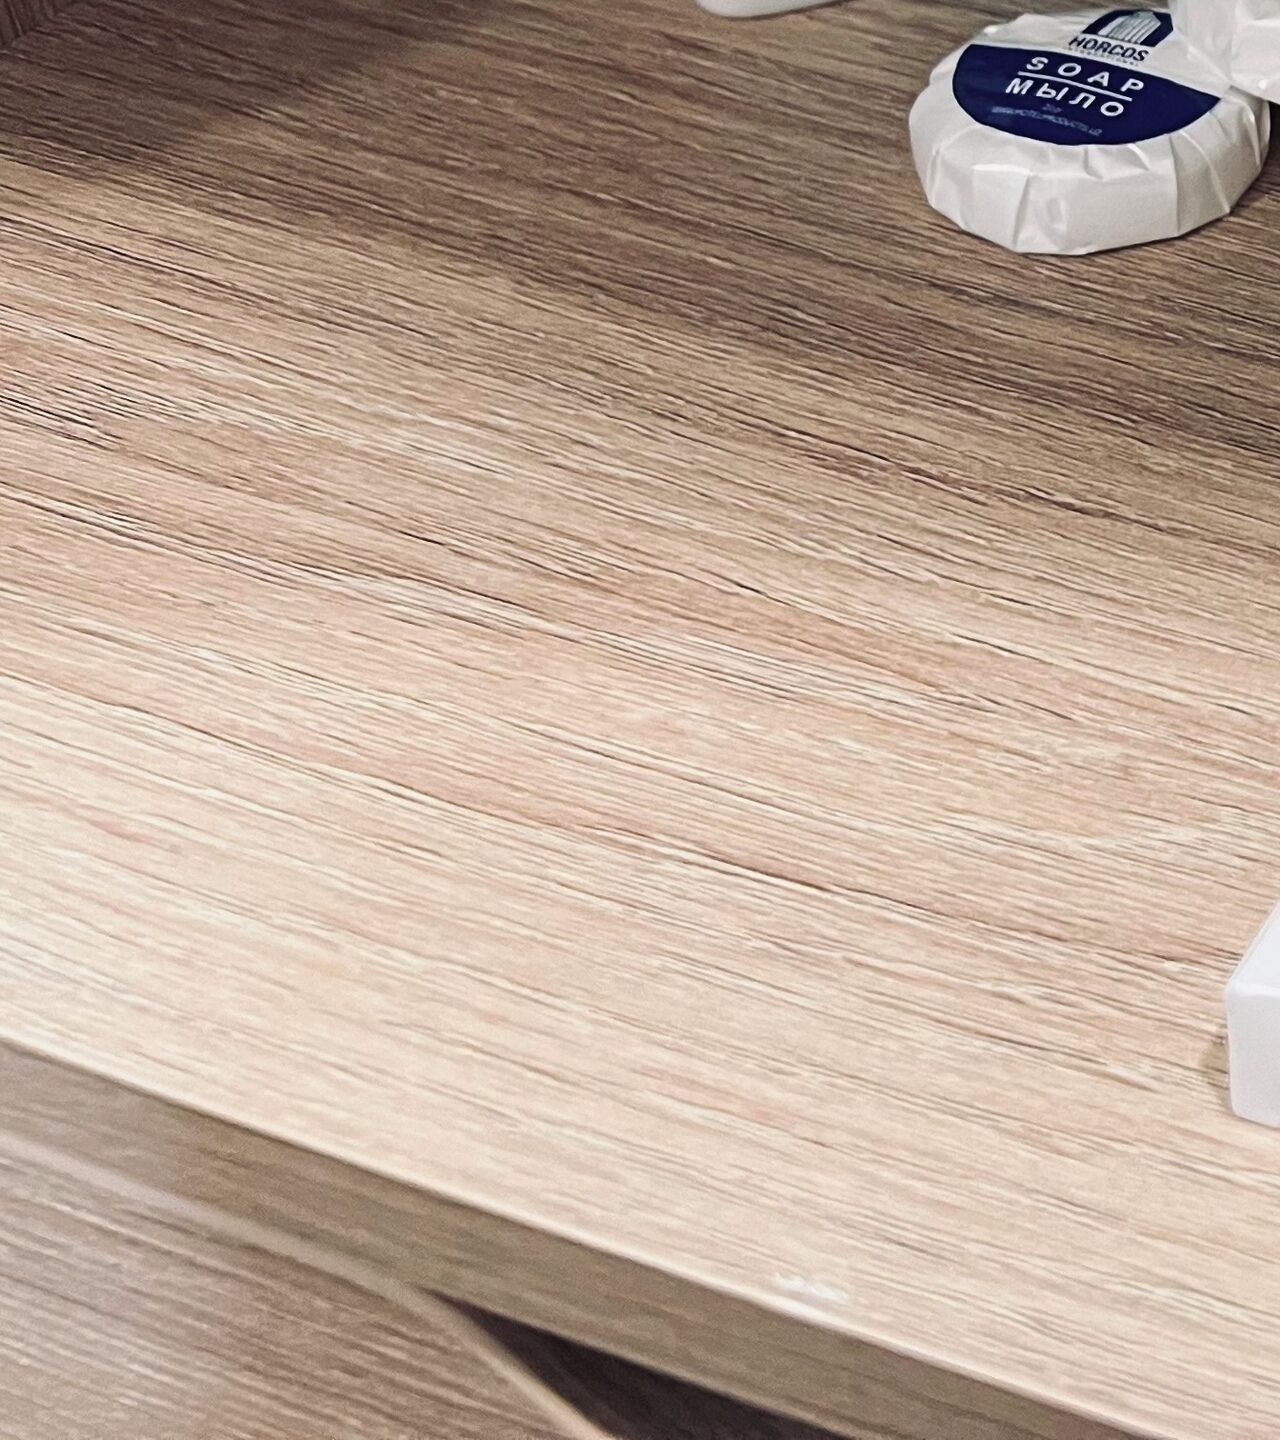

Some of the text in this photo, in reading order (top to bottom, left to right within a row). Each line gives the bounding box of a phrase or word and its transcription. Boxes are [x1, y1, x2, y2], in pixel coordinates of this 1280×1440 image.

[1068, 36, 1149, 61] HORCOS
[1026, 57, 1145, 92] SOAP
[1005, 78, 1125, 116] МЫЛО
